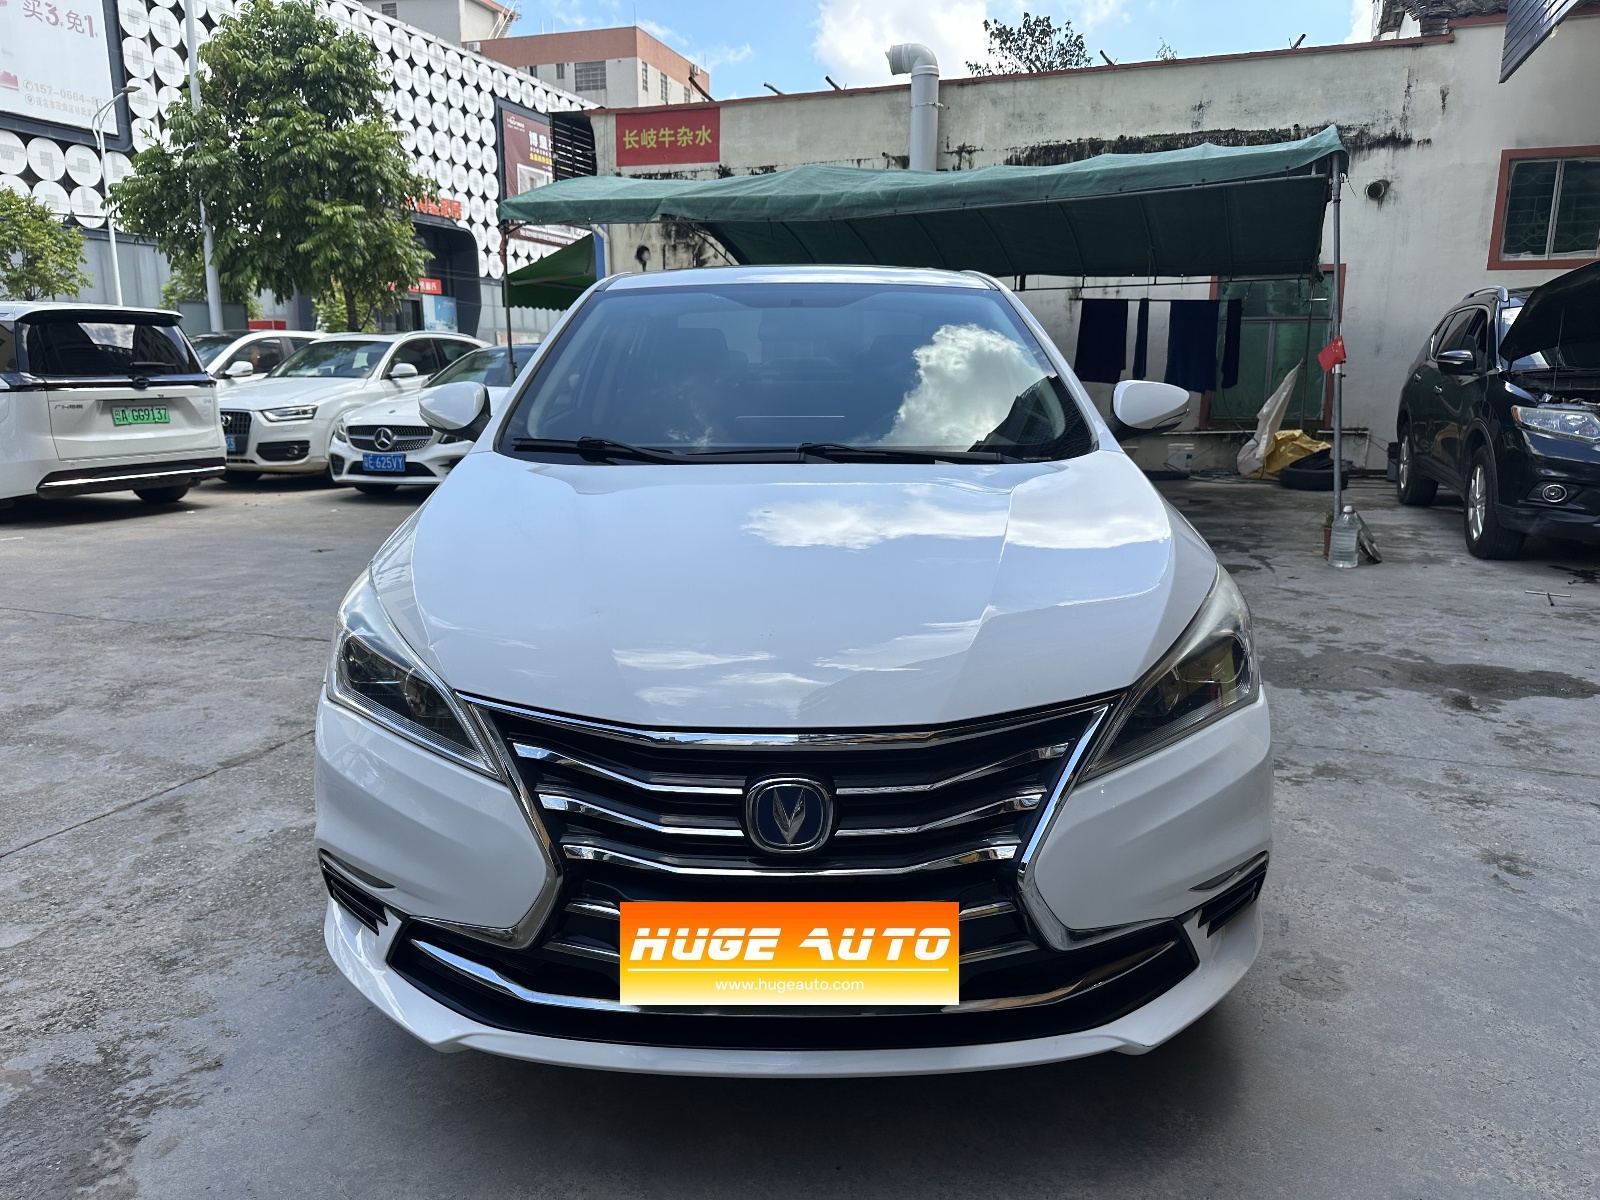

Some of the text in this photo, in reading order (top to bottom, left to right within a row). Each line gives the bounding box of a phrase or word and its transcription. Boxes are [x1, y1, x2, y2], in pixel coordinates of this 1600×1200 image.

[623, 125, 712, 149] 长岐牛杂水
